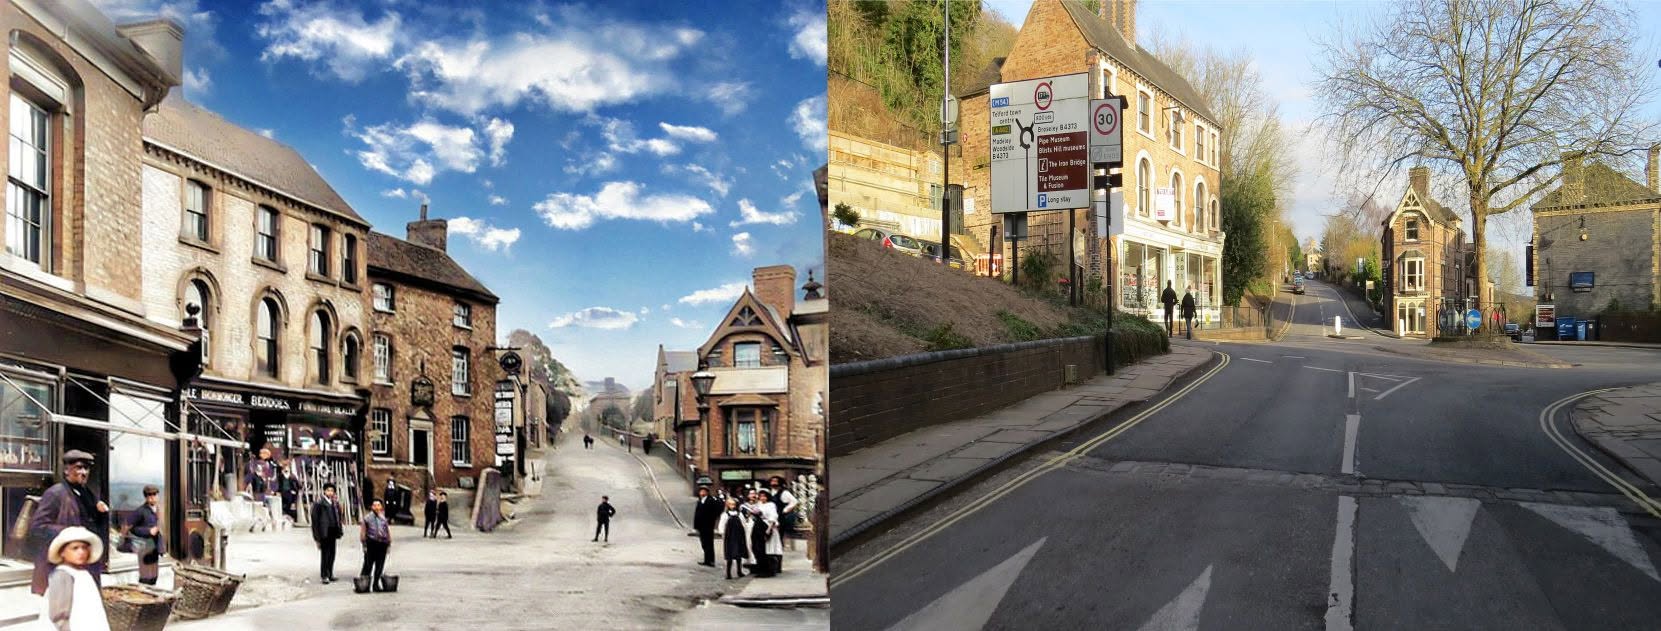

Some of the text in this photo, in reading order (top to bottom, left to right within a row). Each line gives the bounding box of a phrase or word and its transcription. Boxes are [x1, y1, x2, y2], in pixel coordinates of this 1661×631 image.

[992, 110, 1009, 118] Telford
[1098, 113, 1113, 126] 30
[1038, 137, 1049, 145] Pipe
[1048, 160, 1058, 168] The
[1069, 159, 1086, 167] Bridge
[1048, 174, 1069, 182] Museum
[1047, 196, 1060, 204] Long
[1060, 195, 1072, 203] stay
